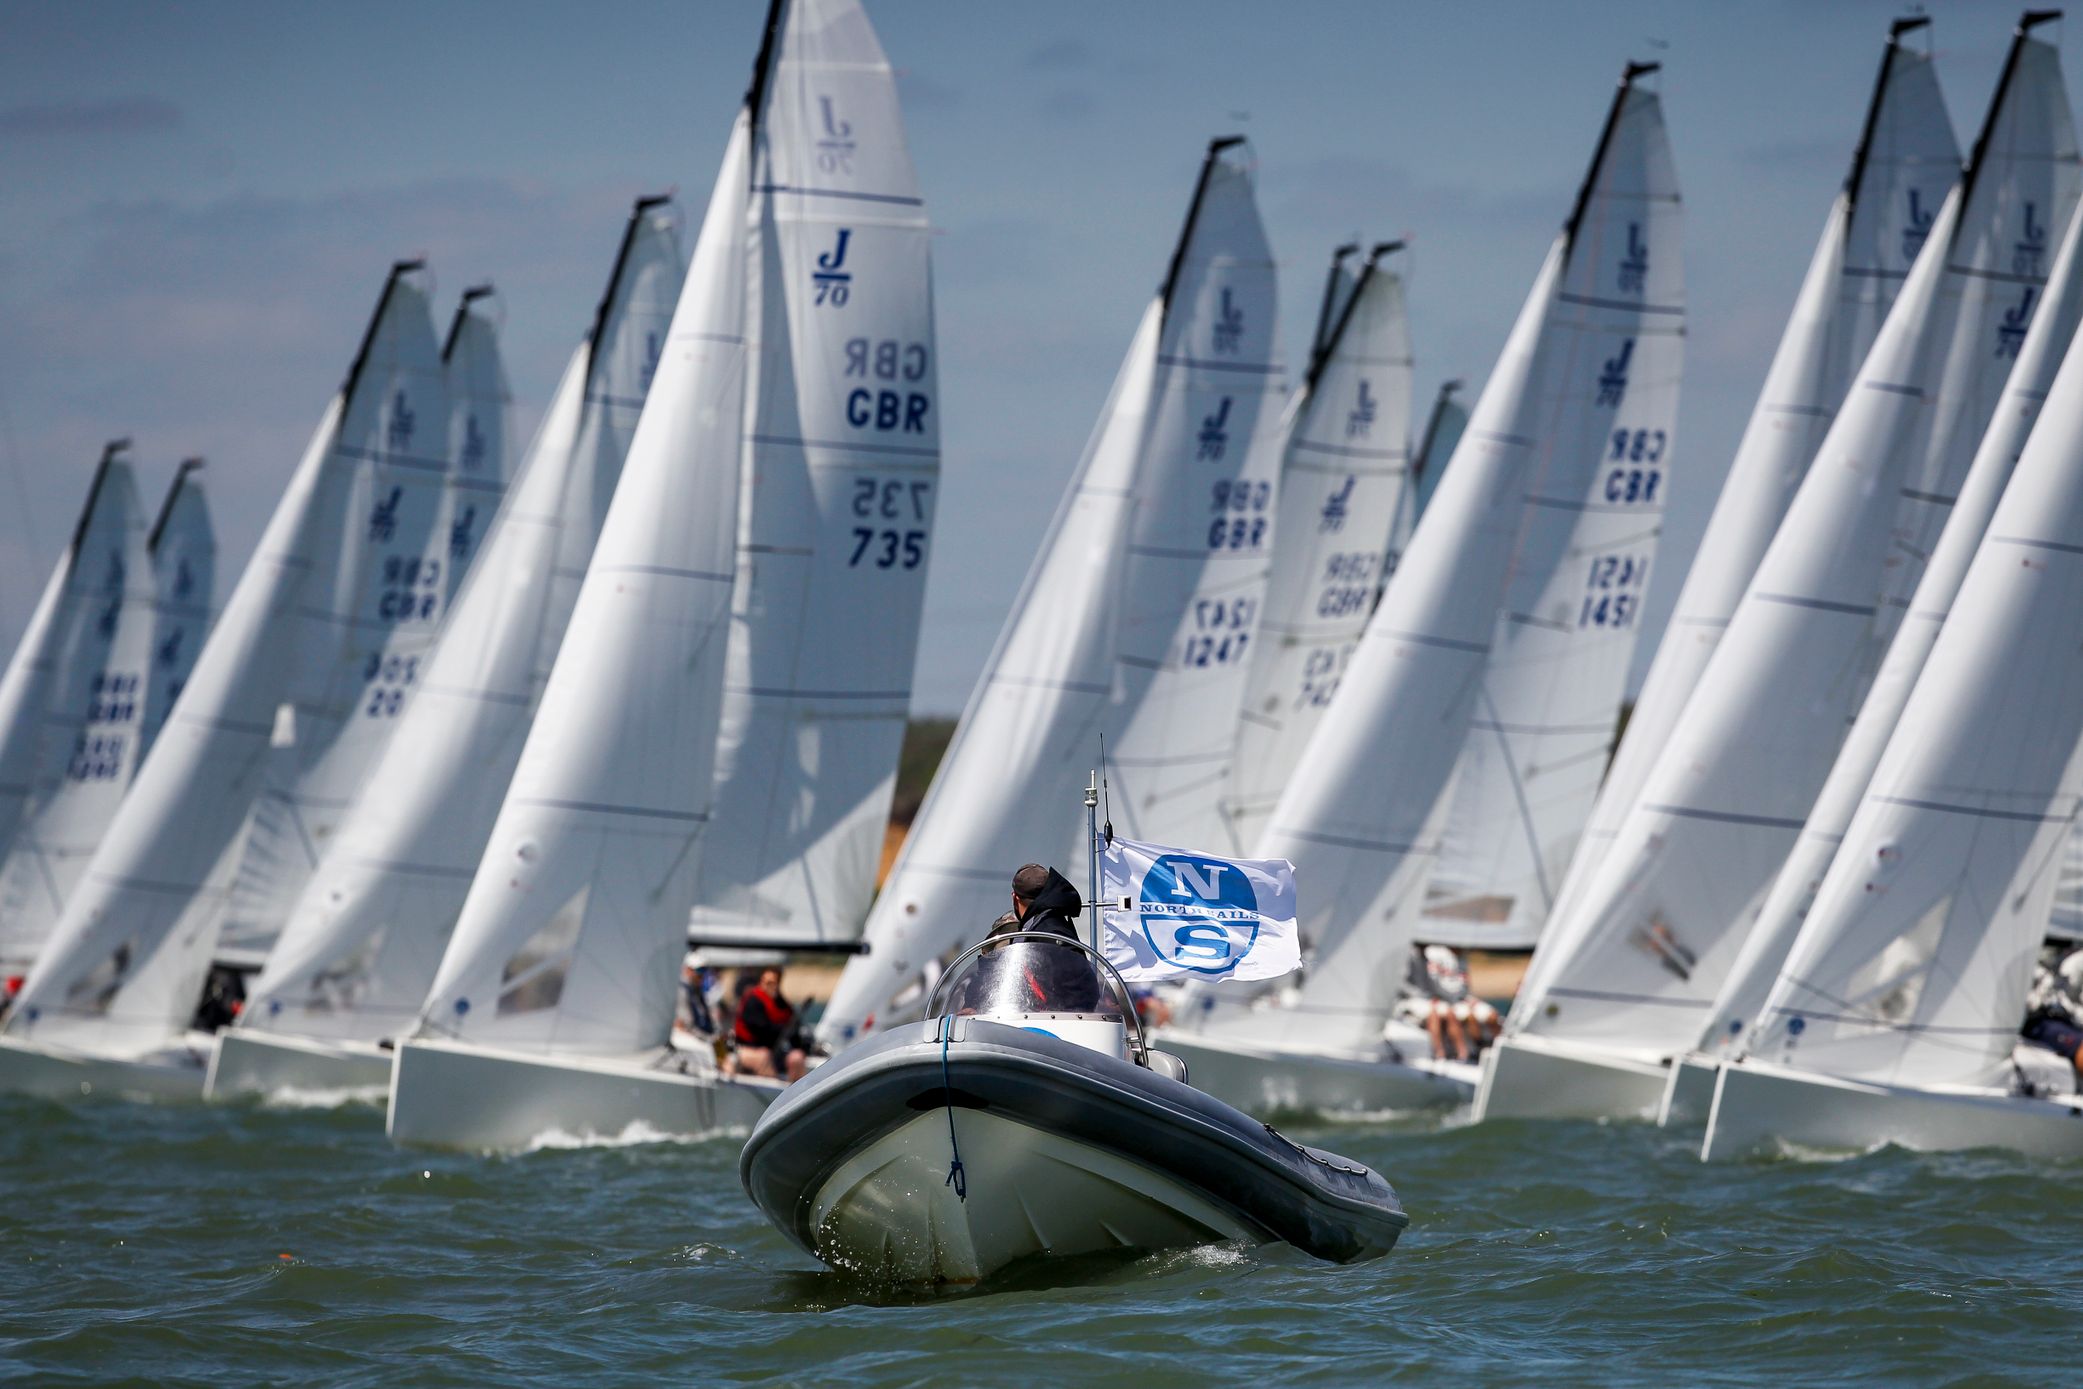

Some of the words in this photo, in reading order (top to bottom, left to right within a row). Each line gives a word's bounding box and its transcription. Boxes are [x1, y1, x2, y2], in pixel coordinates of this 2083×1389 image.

[818, 229, 851, 270] J
[813, 283, 850, 307] 70
[846, 387, 928, 434] GBR
[1605, 469, 1660, 502] GBR
[849, 526, 926, 570] 735
[1207, 517, 1267, 549] GBR
[1578, 594, 1640, 629] 1451
[1184, 632, 1249, 668] 1247
[1166, 861, 1229, 900] N
[1174, 925, 1231, 961] S
